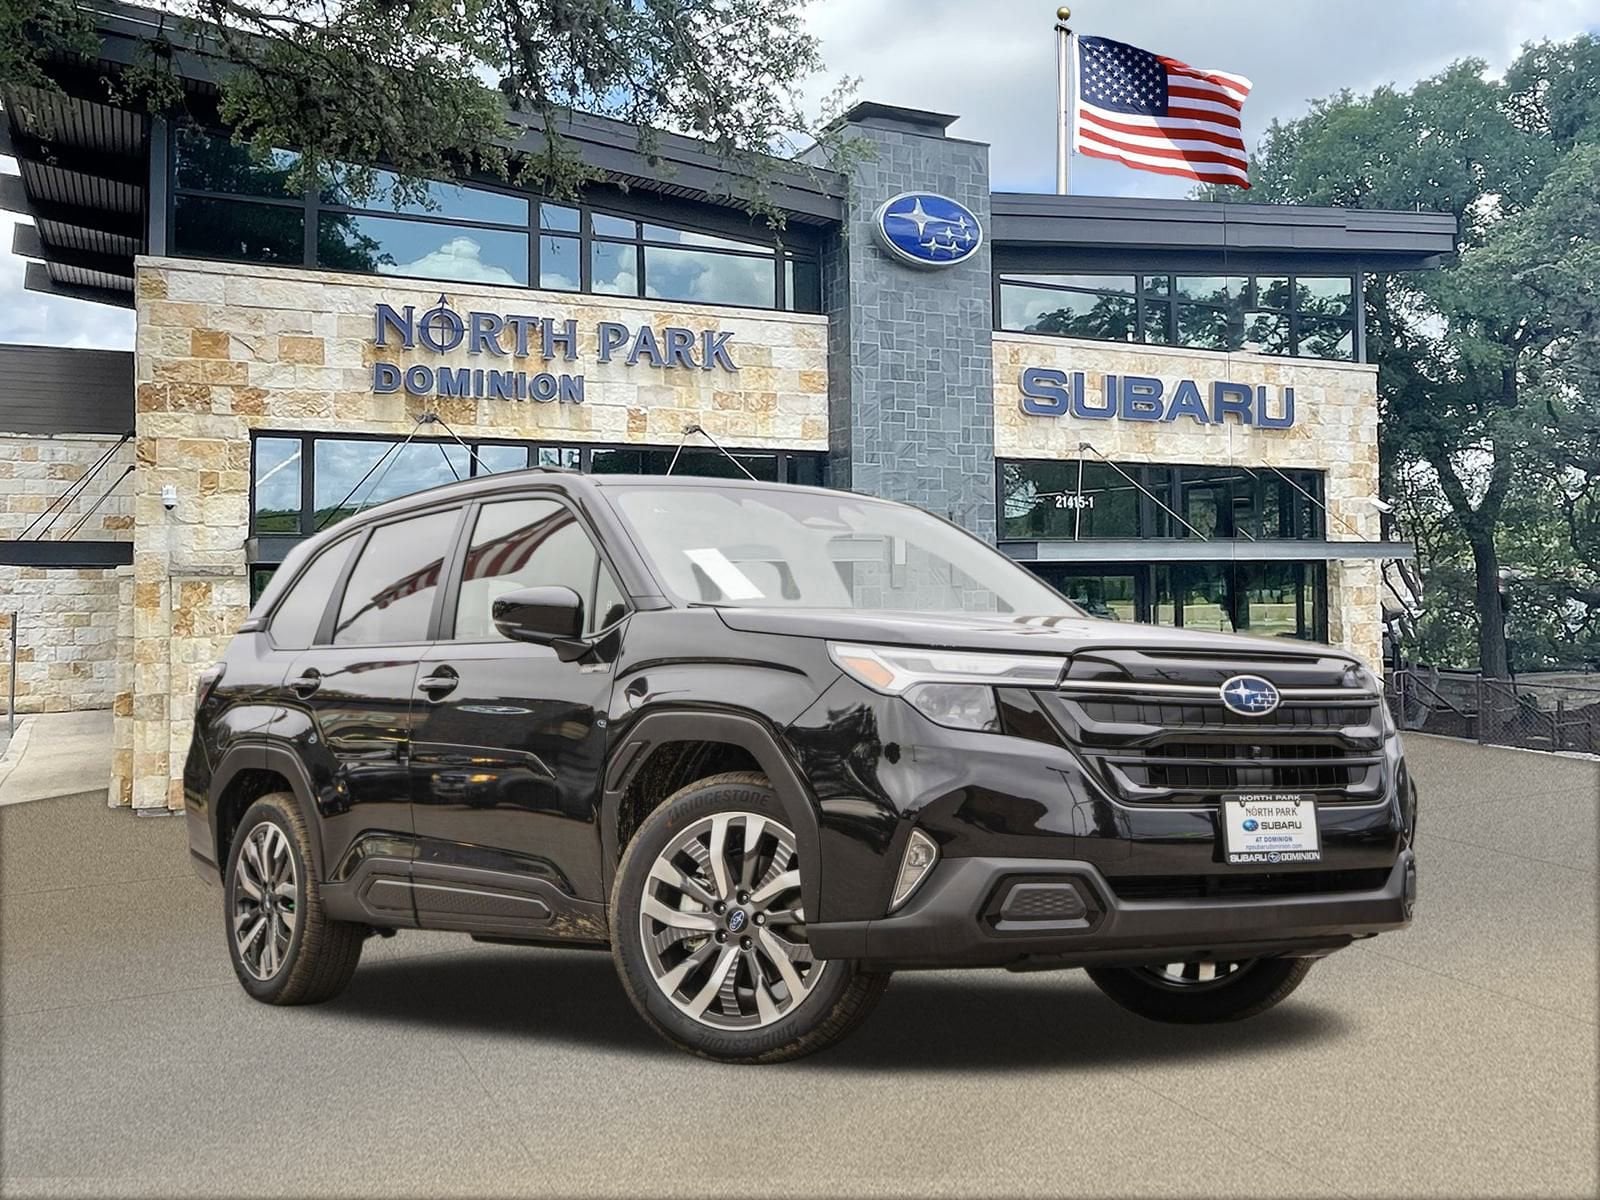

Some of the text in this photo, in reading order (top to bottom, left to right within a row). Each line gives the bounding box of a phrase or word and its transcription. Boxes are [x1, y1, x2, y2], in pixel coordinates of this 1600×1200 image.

[375, 301, 742, 373] NORTH PARK
[373, 361, 585, 404] DOMINION
[1019, 367, 1295, 430] SUBARU
[1055, 495, 1094, 509] 21415-1
[1245, 806, 1298, 817] NORTH PARK
[1260, 821, 1302, 830] SUBARU
[1230, 851, 1320, 862] SUBARU DOMINION
